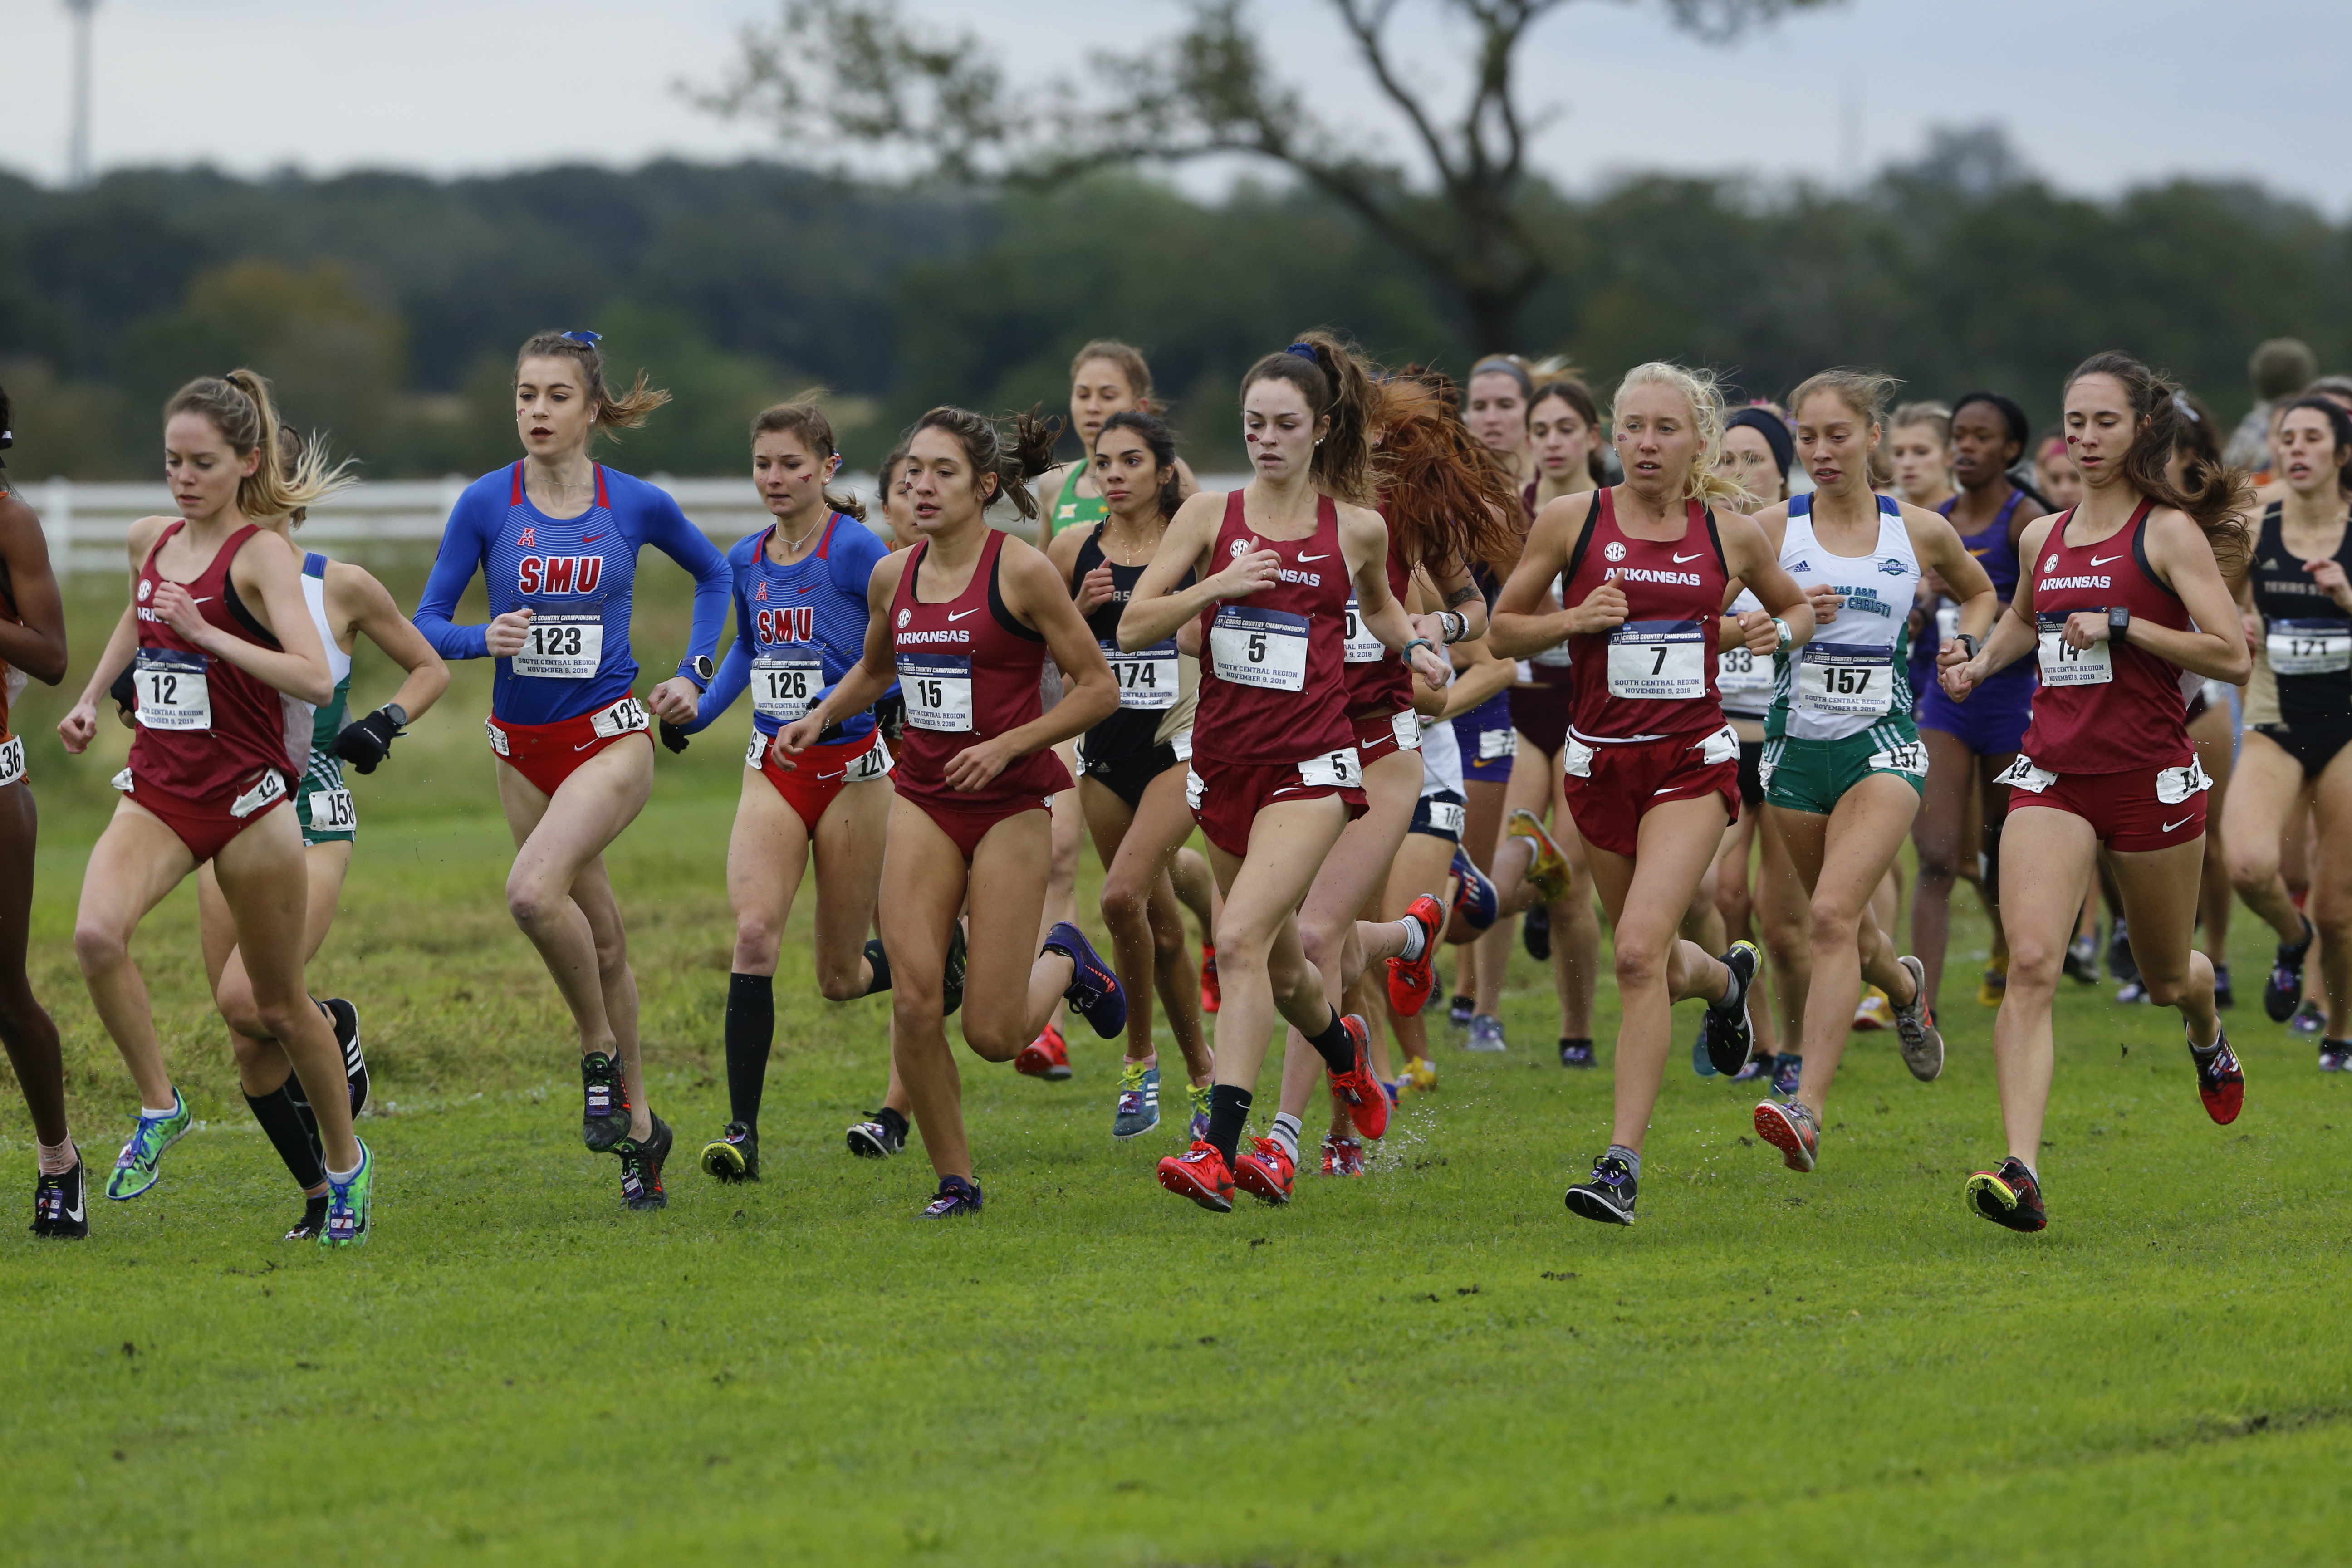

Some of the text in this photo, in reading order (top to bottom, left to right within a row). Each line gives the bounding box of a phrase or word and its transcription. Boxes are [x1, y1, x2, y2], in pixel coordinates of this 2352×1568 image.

[1607, 544, 1624, 560] SEC
[2045, 555, 2057, 573] SEC
[519, 556, 603, 594] SMU
[1279, 568, 1320, 587] NSAS
[2038, 576, 2111, 592] ARKANSAS
[1833, 586, 1877, 599] XAS A&M
[898, 610, 910, 627] SEC
[1848, 597, 1891, 618] CHRISTI
[758, 607, 813, 645] SMU
[896, 630, 969, 645] ARKANSAS
[1265, 622, 1306, 633] CHAMPIONSHIPS
[532, 627, 581, 655] 123
[1249, 634, 1266, 662] 5
[2058, 637, 2079, 662] 14
[2291, 640, 2327, 655] 171
[1218, 662, 1298, 678] SOUTH CENTRAL REGION
[1651, 647, 1667, 675] 7
[1725, 651, 1753, 672] 33
[768, 672, 806, 698] 126
[1111, 663, 1156, 688] 174
[1227, 672, 1260, 682] NOVEMBER
[1824, 668, 1871, 694] 157
[152, 675, 177, 704] 12
[918, 680, 941, 708] 15
[1721, 730, 1735, 747] 7
[1332, 753, 1347, 780] 5
[1890, 744, 1919, 769] 157
[259, 776, 279, 801] 12
[328, 793, 354, 826] 158
